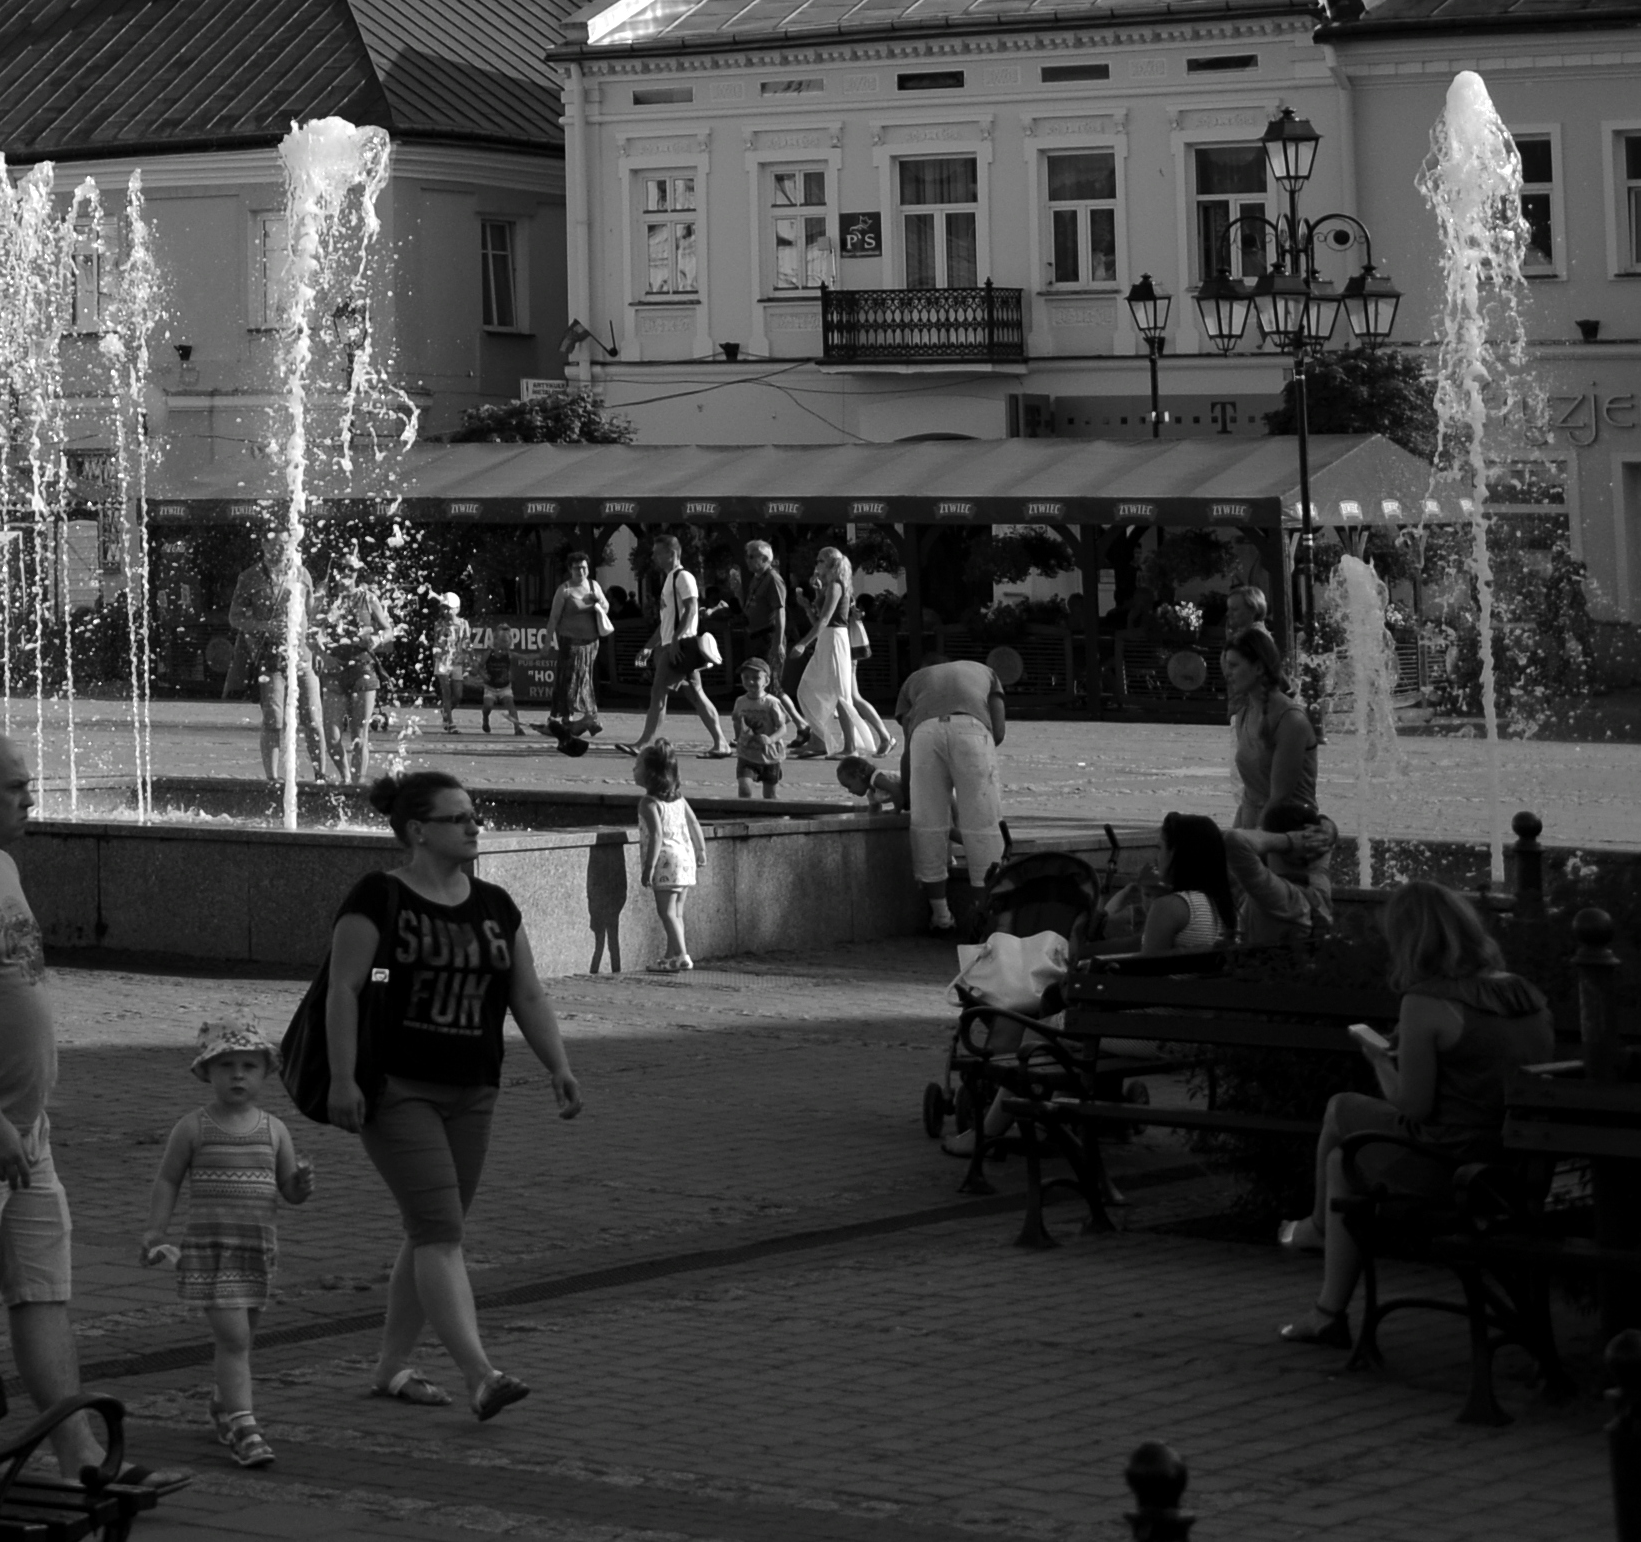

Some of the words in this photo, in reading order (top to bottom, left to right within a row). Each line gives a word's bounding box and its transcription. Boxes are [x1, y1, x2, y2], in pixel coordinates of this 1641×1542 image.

[1211, 401, 1236, 434] T
[529, 686, 554, 698] RYN
[395, 910, 481, 969] SUN
[405, 970, 493, 1028] FUN
